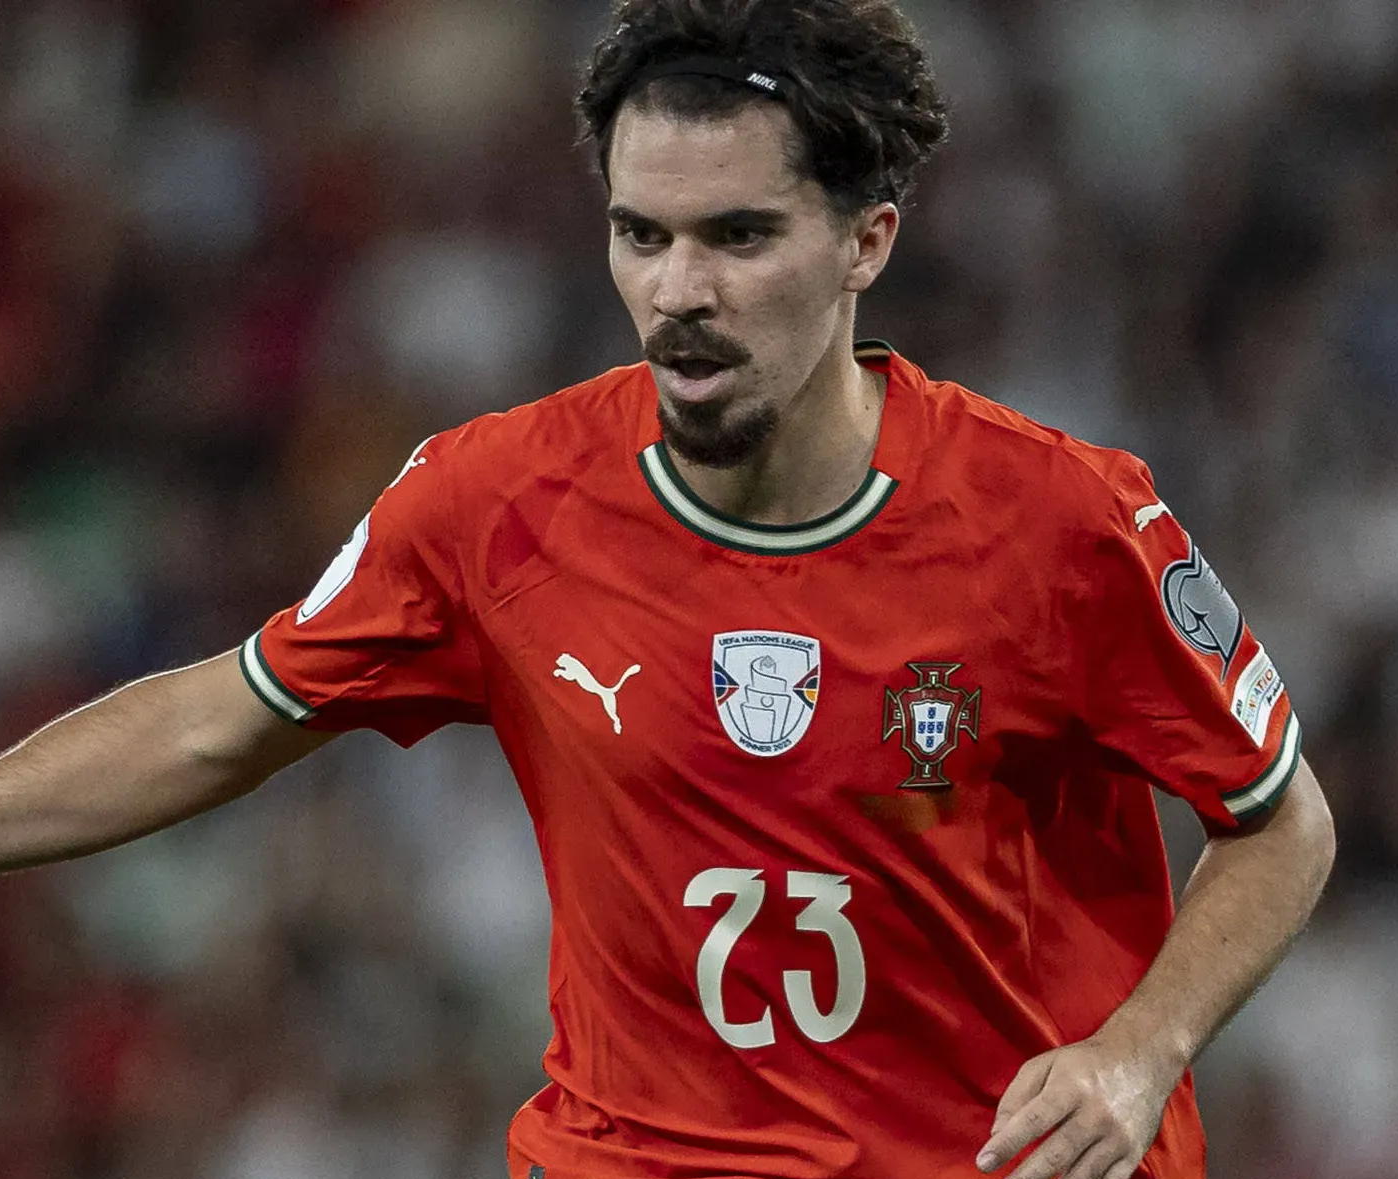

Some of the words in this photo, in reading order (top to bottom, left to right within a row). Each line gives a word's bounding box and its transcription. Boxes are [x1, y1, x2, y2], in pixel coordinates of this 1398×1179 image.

[746, 72, 777, 91] NIKE
[718, 637, 740, 646] UEFA
[741, 635, 780, 644] NATIONS
[781, 637, 815, 651] LEAGUE
[739, 736, 772, 752] WINNER
[683, 867, 866, 1049] 23
